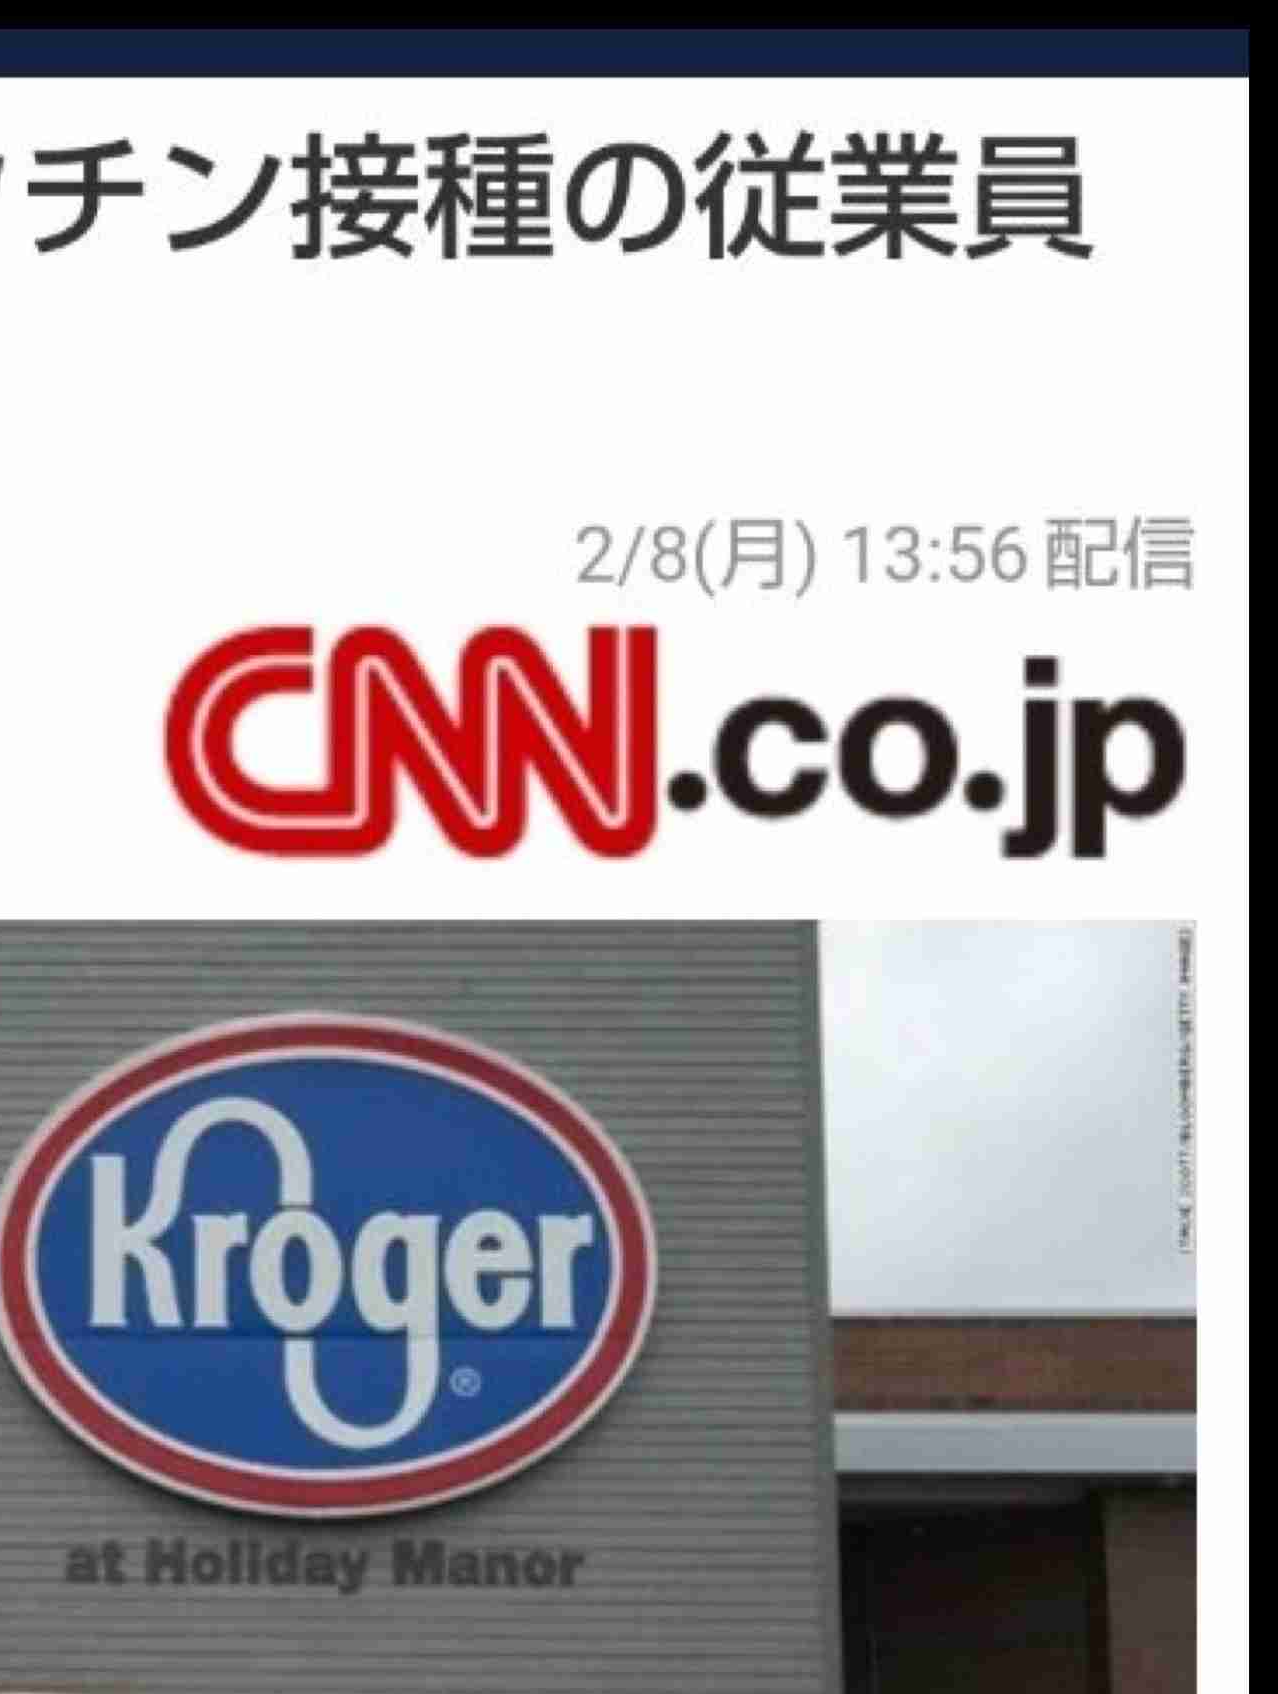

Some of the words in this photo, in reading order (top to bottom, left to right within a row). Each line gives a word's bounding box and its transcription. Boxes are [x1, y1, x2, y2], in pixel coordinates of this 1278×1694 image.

[577, 519, 816, 598] 2/8(月)
[844, 525, 1027, 583] 13:56
[1045, 516, 1195, 590] 配信
[162, 623, 1187, 861] CNN.co.jp
[90, 1097, 594, 1449] Kroger
[65, 1540, 126, 1585] at
[144, 1537, 368, 1595] Holiday
[392, 1540, 585, 1588] Manor
